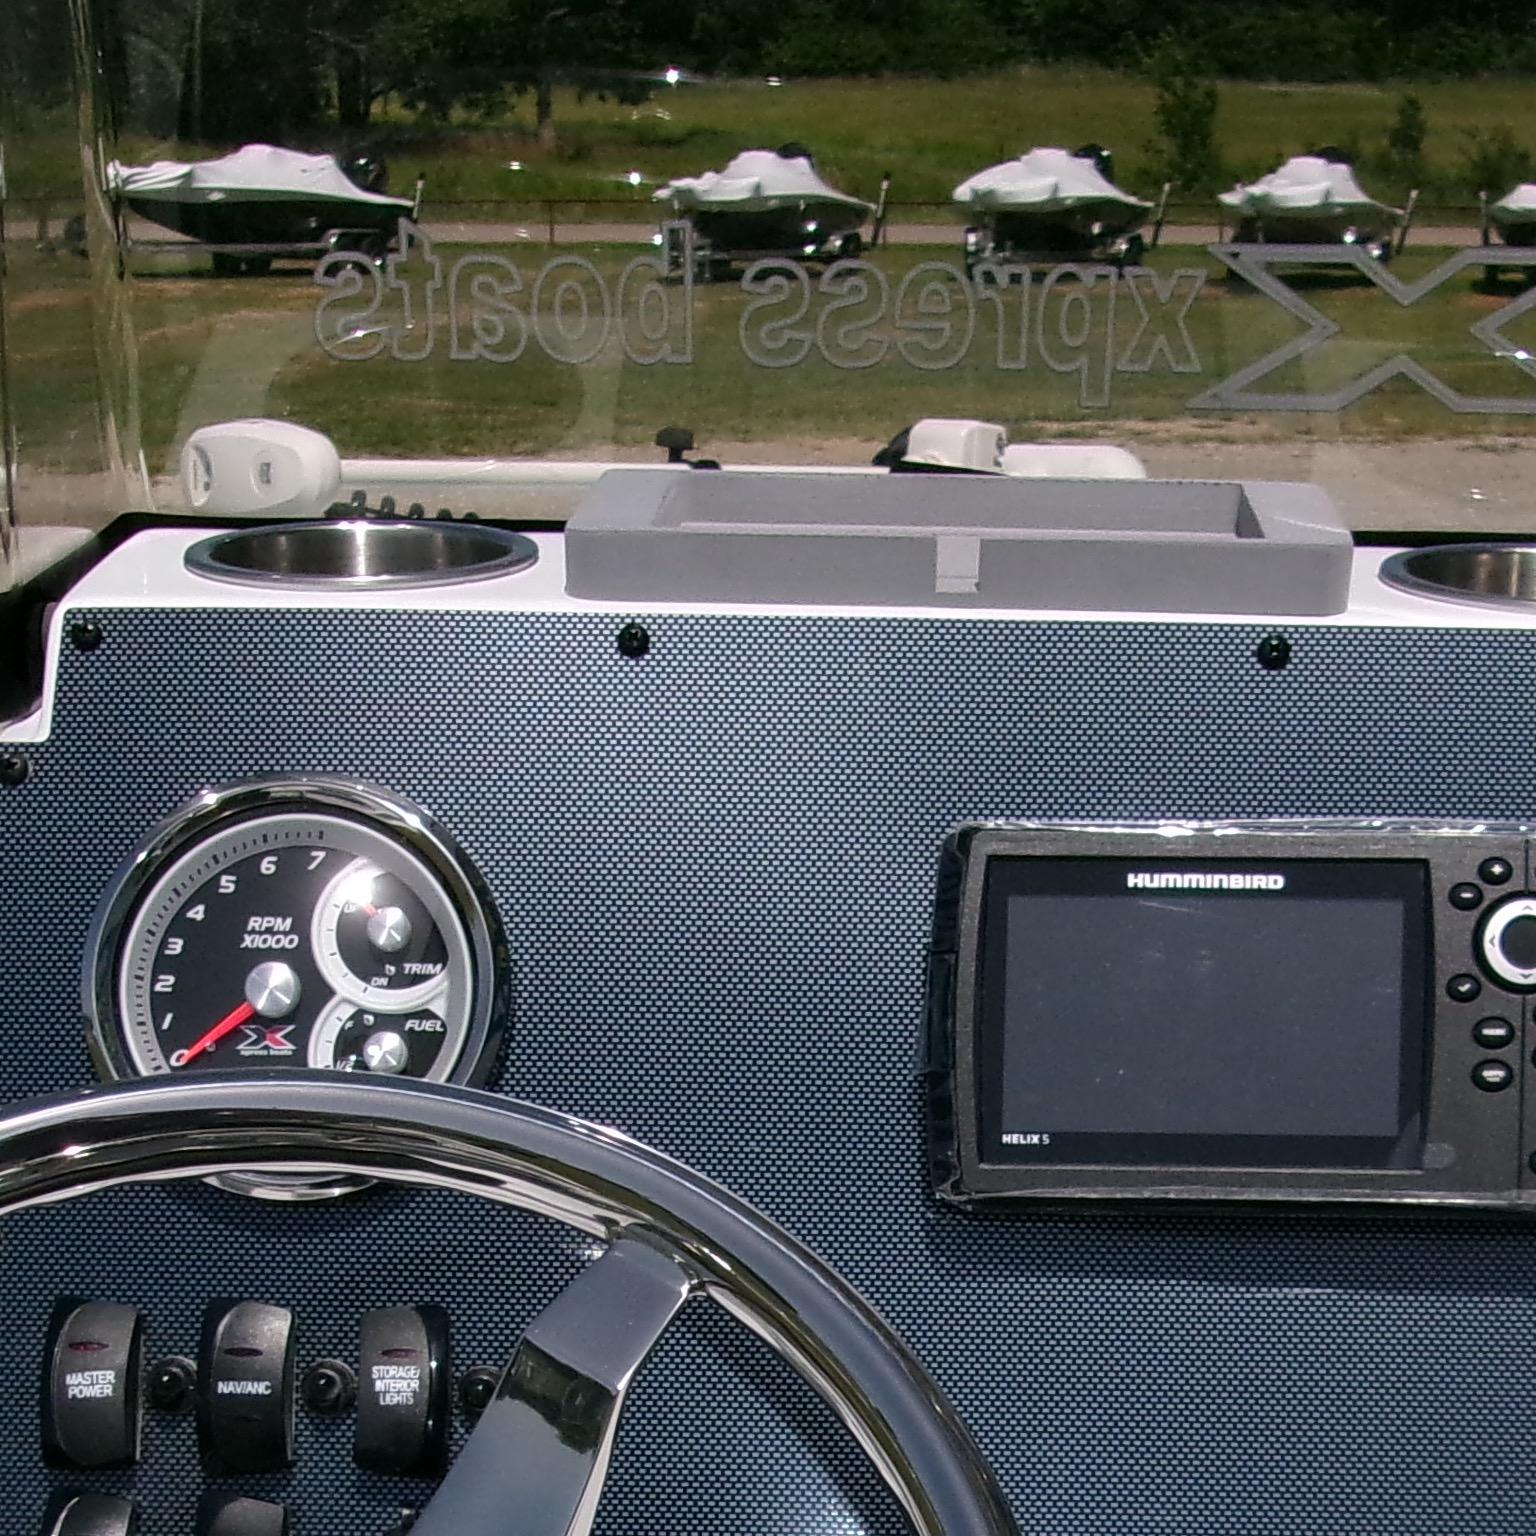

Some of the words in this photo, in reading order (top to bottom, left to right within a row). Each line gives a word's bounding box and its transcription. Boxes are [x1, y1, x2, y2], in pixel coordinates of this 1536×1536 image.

[260, 856, 278, 874] 6
[307, 851, 326, 870] 7
[218, 875, 237, 893] 5
[1127, 873, 1285, 890] HUMMINBIRD
[186, 904, 205, 921] 4
[247, 917, 292, 931] RPM
[164, 938, 184, 955] 3
[240, 934, 299, 949] X1000
[403, 963, 443, 975] TRIM
[154, 975, 175, 992] 2
[371, 977, 389, 986] DN
[162, 1013, 173, 1030] 1
[344, 1020, 355, 1031] F
[404, 1020, 444, 1032] FUEL
[169, 1049, 189, 1067] 0
[1002, 1133, 1040, 1145] HELIX
[1042, 1133, 1050, 1145] 5
[65, 1370, 115, 1385] MASTER
[68, 1384, 113, 1399] POWER
[375, 1379, 420, 1392] INTERIOR
[379, 1392, 414, 1405] LIGHTS
